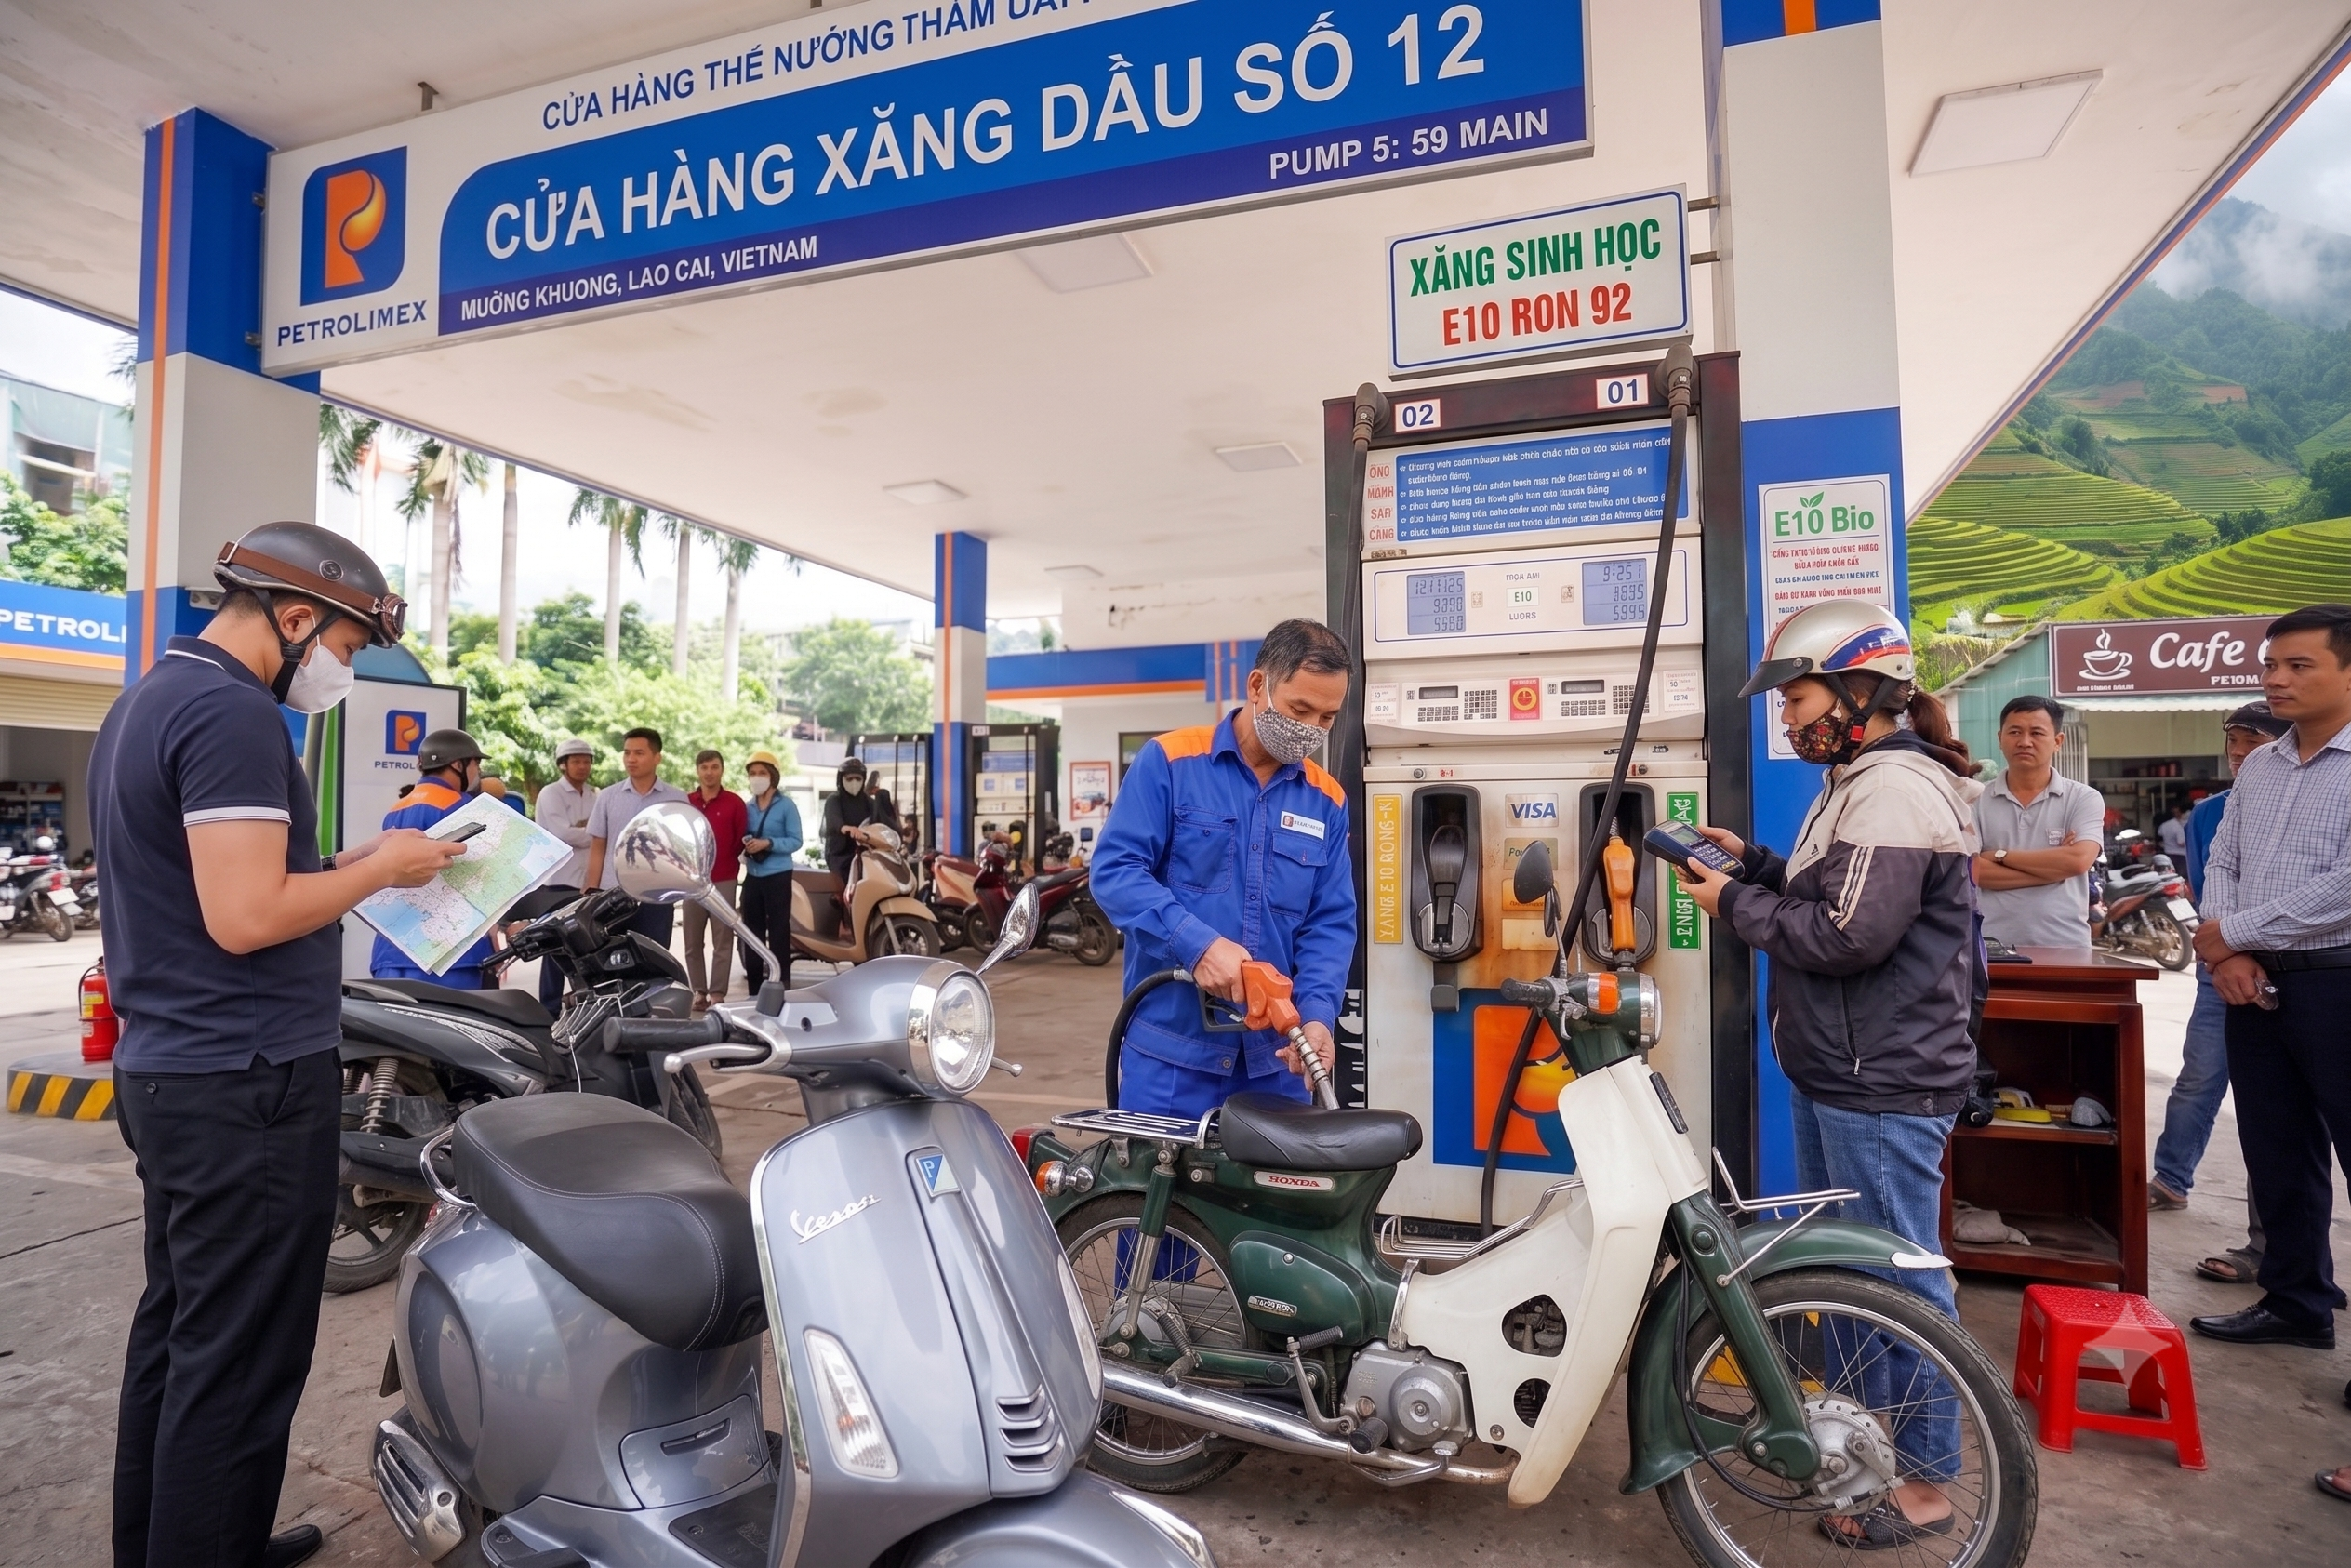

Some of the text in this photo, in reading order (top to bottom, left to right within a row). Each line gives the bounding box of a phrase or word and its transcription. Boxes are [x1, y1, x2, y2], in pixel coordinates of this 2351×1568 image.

[543, 92, 603, 130] CỬA
[612, 69, 694, 114] HÀNG
[704, 44, 764, 91] THẾ
[773, 20, 894, 75] NƯỚNG
[485, 3, 1485, 260] CỬA HÀNG XĂNG DẦU SỐ 12
[1269, 107, 1548, 179] PUMP 5: 59 MAIN
[536, 273, 621, 308] KHUONG,
[628, 263, 670, 291] LAO
[675, 256, 716, 286] CAI,
[721, 235, 817, 276] VIETNAM
[1410, 218, 1661, 297] XĂNG SINH HỌC
[277, 299, 427, 347] PETROLIMEX
[1442, 282, 1632, 346] E10 RON 92
[1607, 379, 1640, 404] 01
[1401, 404, 1434, 428] 02
[1774, 505, 1874, 537] E10 Bio
[1514, 591, 1532, 603] E10
[2150, 631, 2245, 673] Cafe
[1510, 802, 1557, 819] VISA
